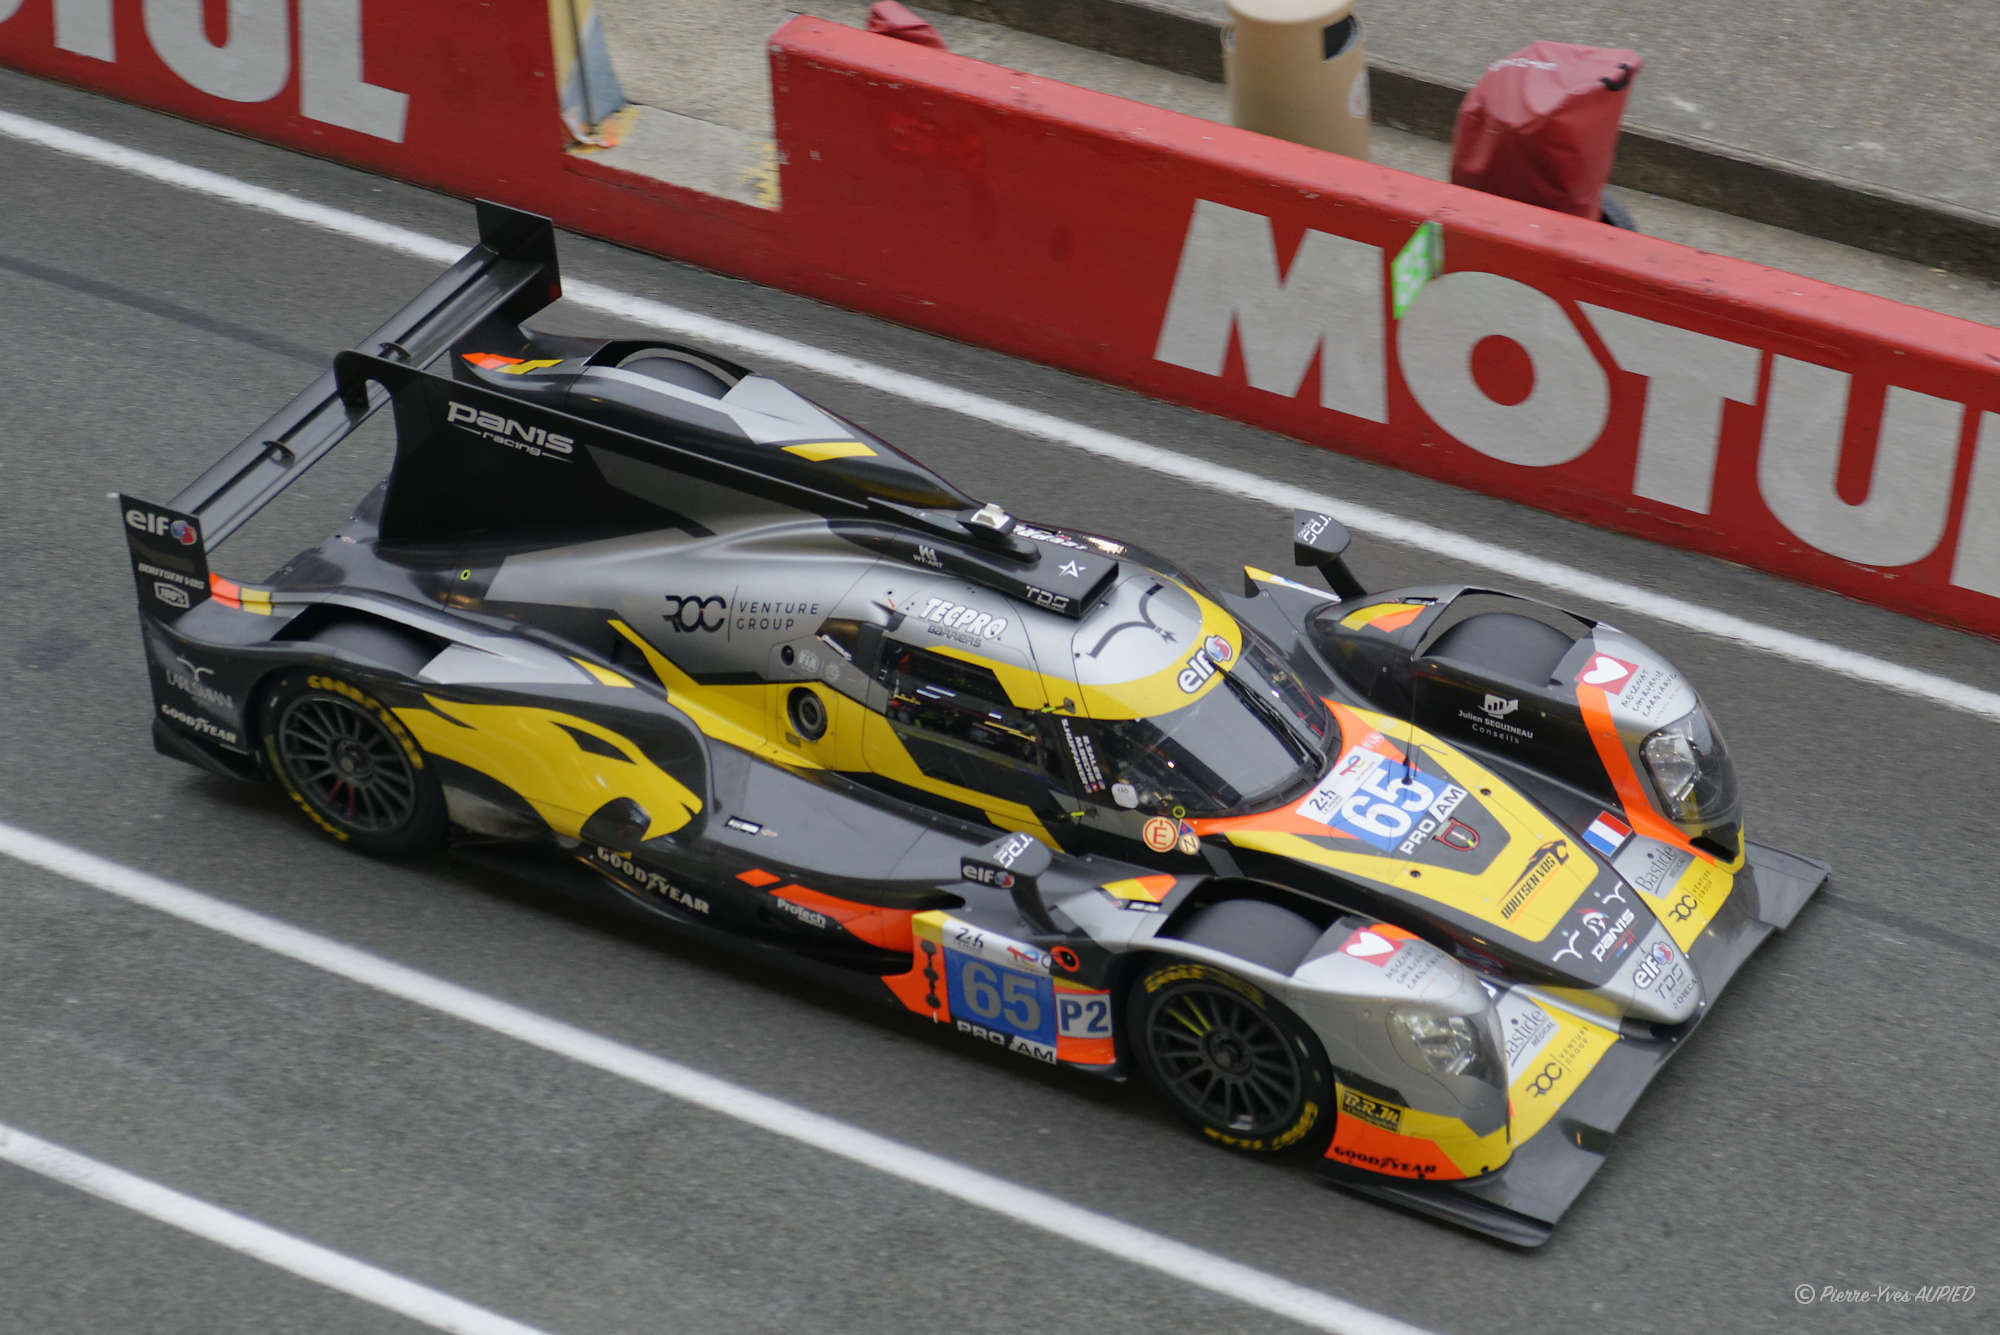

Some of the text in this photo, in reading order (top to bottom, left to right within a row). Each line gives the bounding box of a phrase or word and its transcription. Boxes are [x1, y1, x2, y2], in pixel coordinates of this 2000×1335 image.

[126, 510, 168, 536] elf
[736, 618, 794, 630] GROUP
[738, 602, 820, 615] VENTURE
[919, 597, 1008, 640] TECPRO
[1458, 709, 1533, 738] Julien SEGUINEAU
[1472, 723, 1519, 744] Conseils
[1341, 767, 1434, 838] 65
[1400, 789, 1464, 855] PRO AM
[597, 846, 710, 914] GOODYEAR
[962, 864, 995, 882] elf
[1635, 846, 1675, 891] Bastide
[1634, 954, 1661, 989] elf
[962, 962, 1041, 1031] 65
[1060, 996, 1109, 1033] P2
[957, 1020, 1054, 1063] PRO AM
[1334, 1147, 1437, 1173] GOODYEAR
